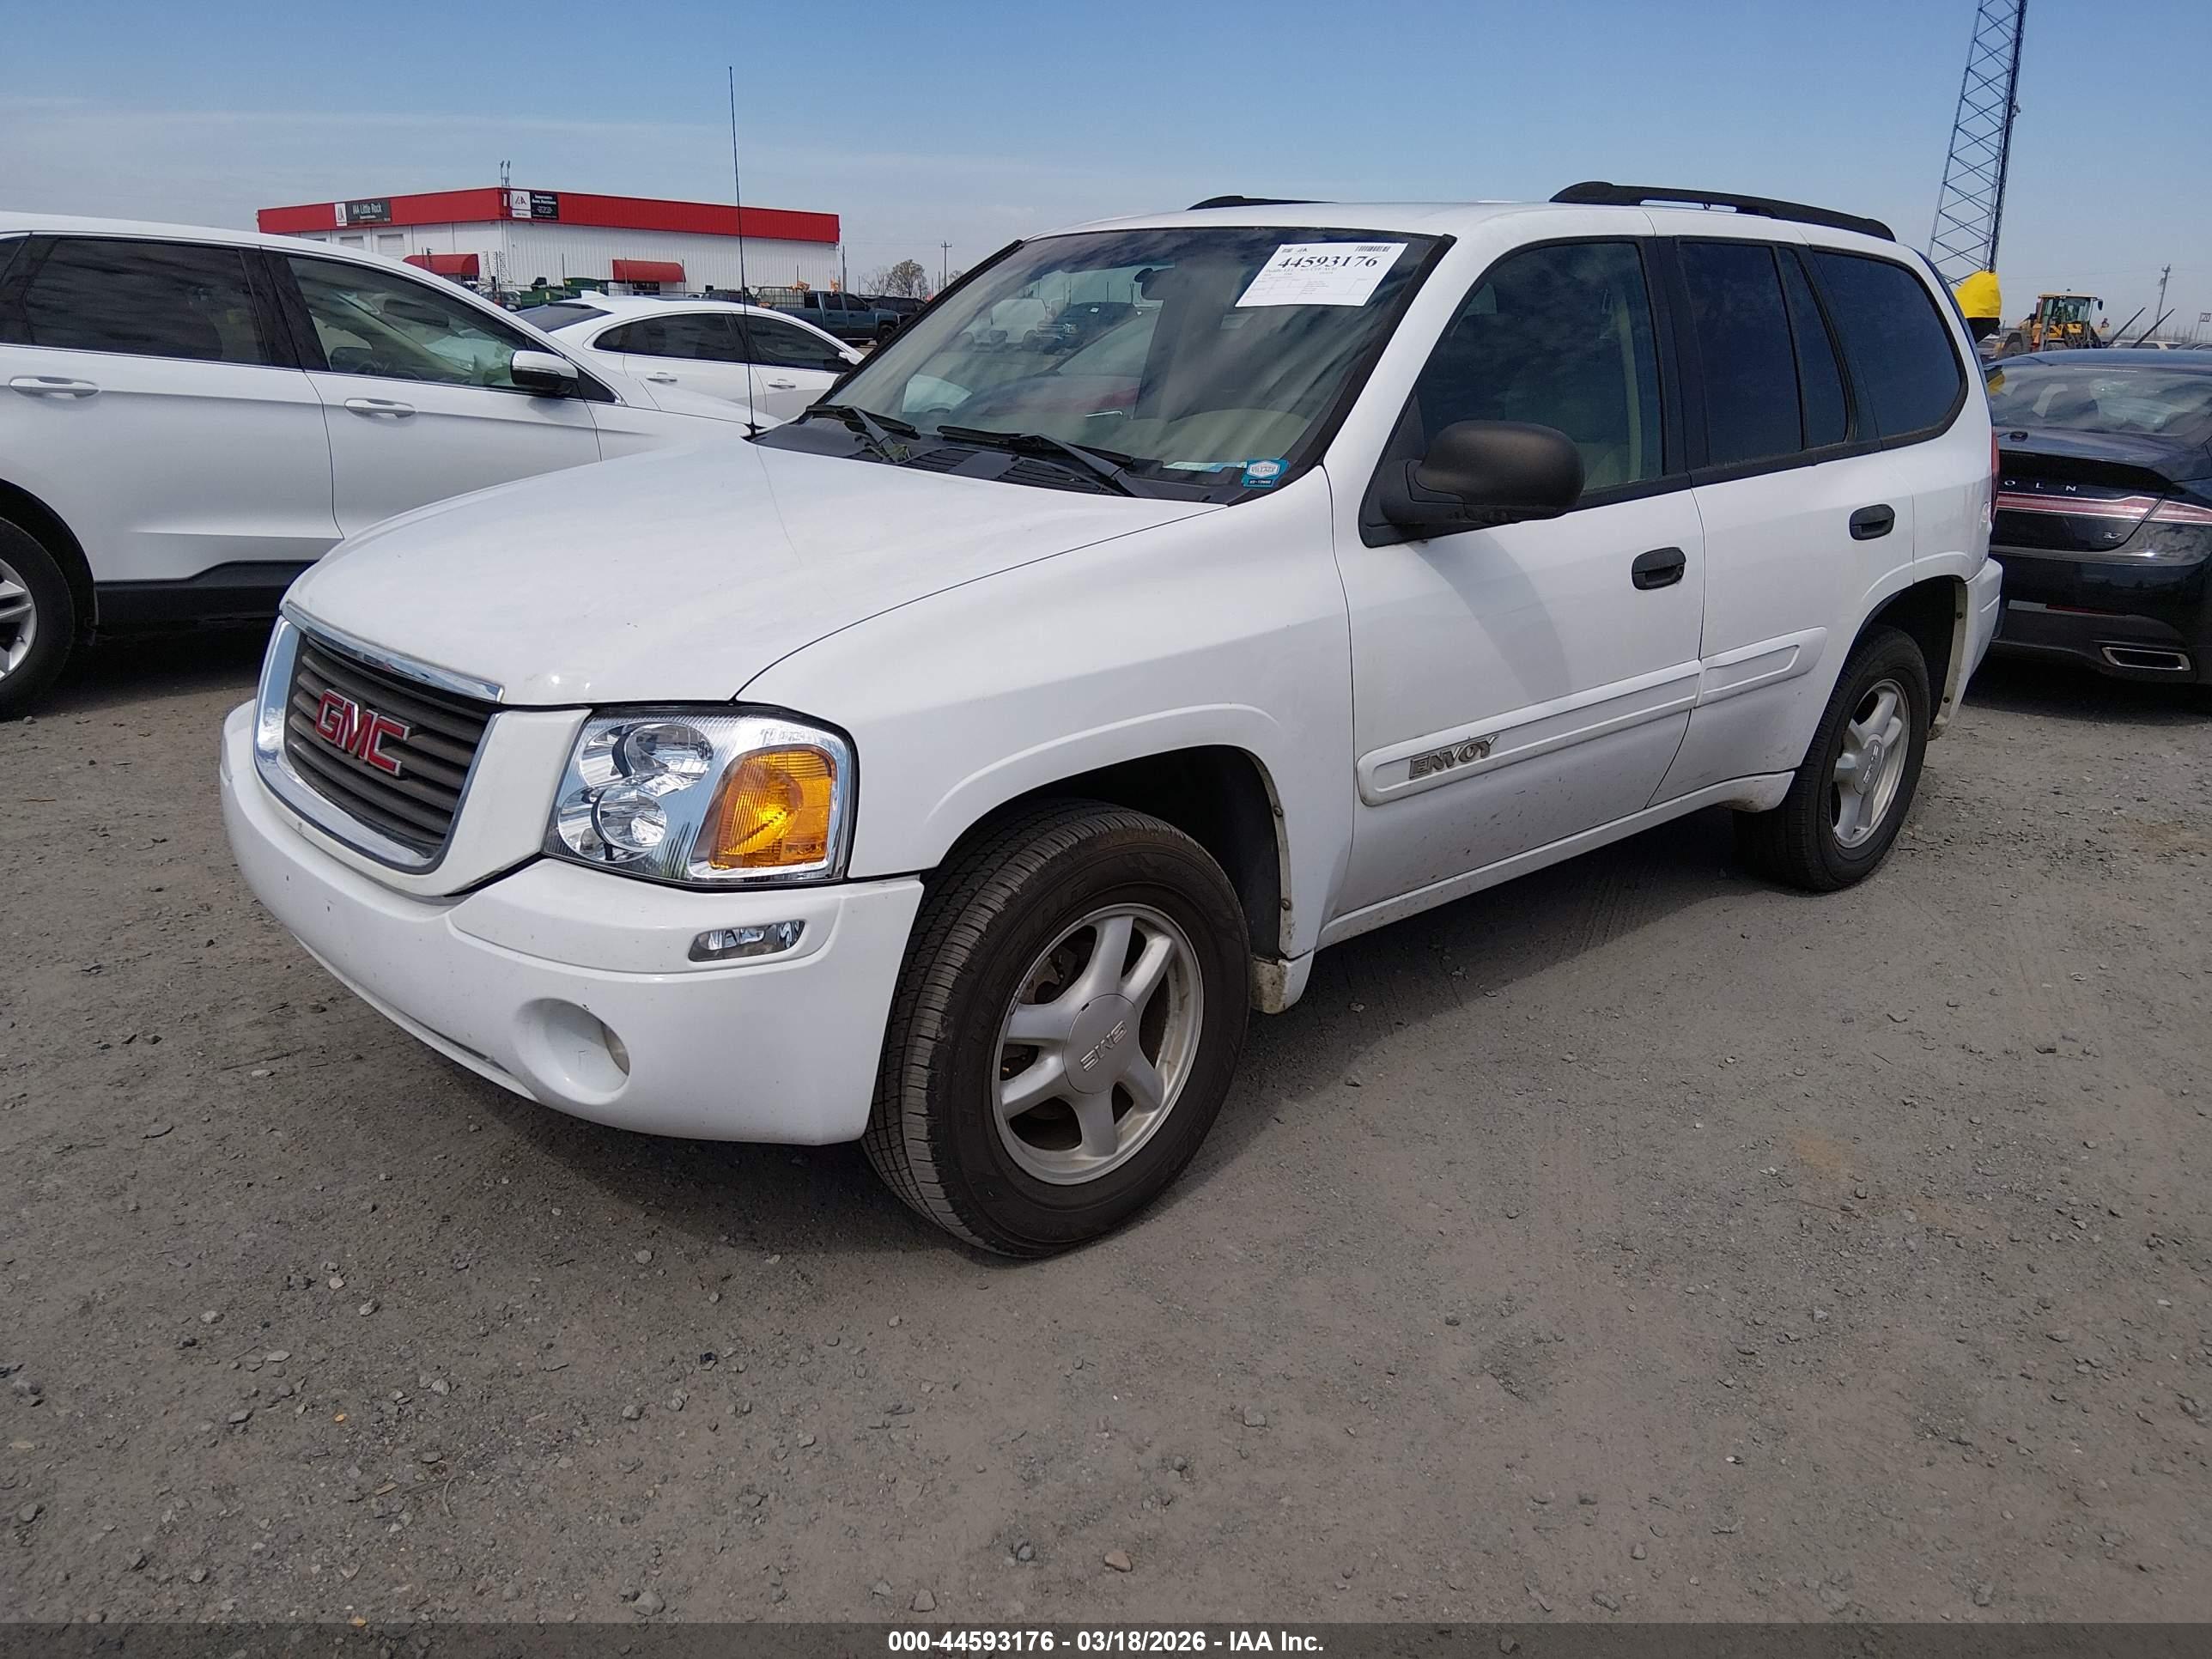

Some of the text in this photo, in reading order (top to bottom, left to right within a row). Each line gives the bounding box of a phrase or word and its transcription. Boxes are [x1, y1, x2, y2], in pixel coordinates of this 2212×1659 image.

[1278, 256, 1380, 268] 44593176
[315, 689, 410, 777] GMC
[1409, 734, 1499, 780] ENVOY
[1079, 1020, 1127, 1072] GMC
